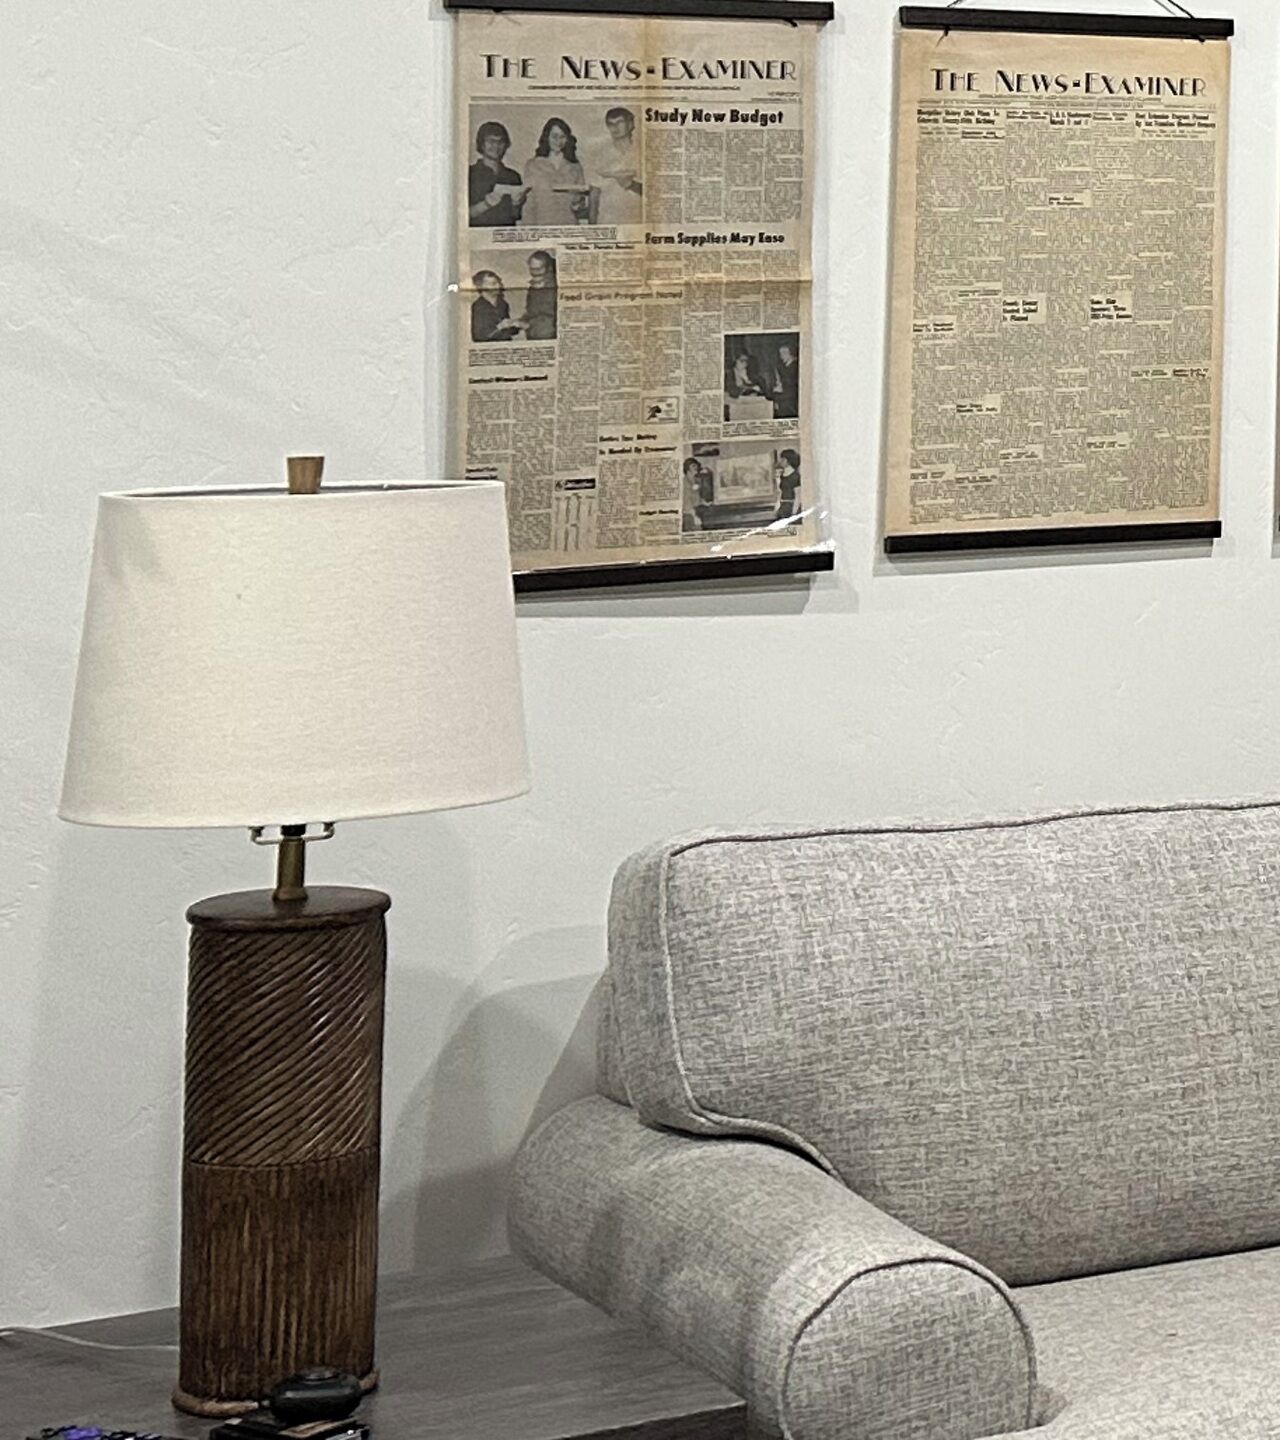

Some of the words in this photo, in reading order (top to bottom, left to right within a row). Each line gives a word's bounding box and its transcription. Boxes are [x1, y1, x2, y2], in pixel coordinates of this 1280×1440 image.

[480, 53, 537, 79] THE
[930, 68, 980, 92] THE
[645, 109, 688, 126] Study
[691, 109, 726, 123] New
[729, 110, 784, 126] Budget
[677, 233, 727, 247] Supplies
[730, 233, 755, 247] May
